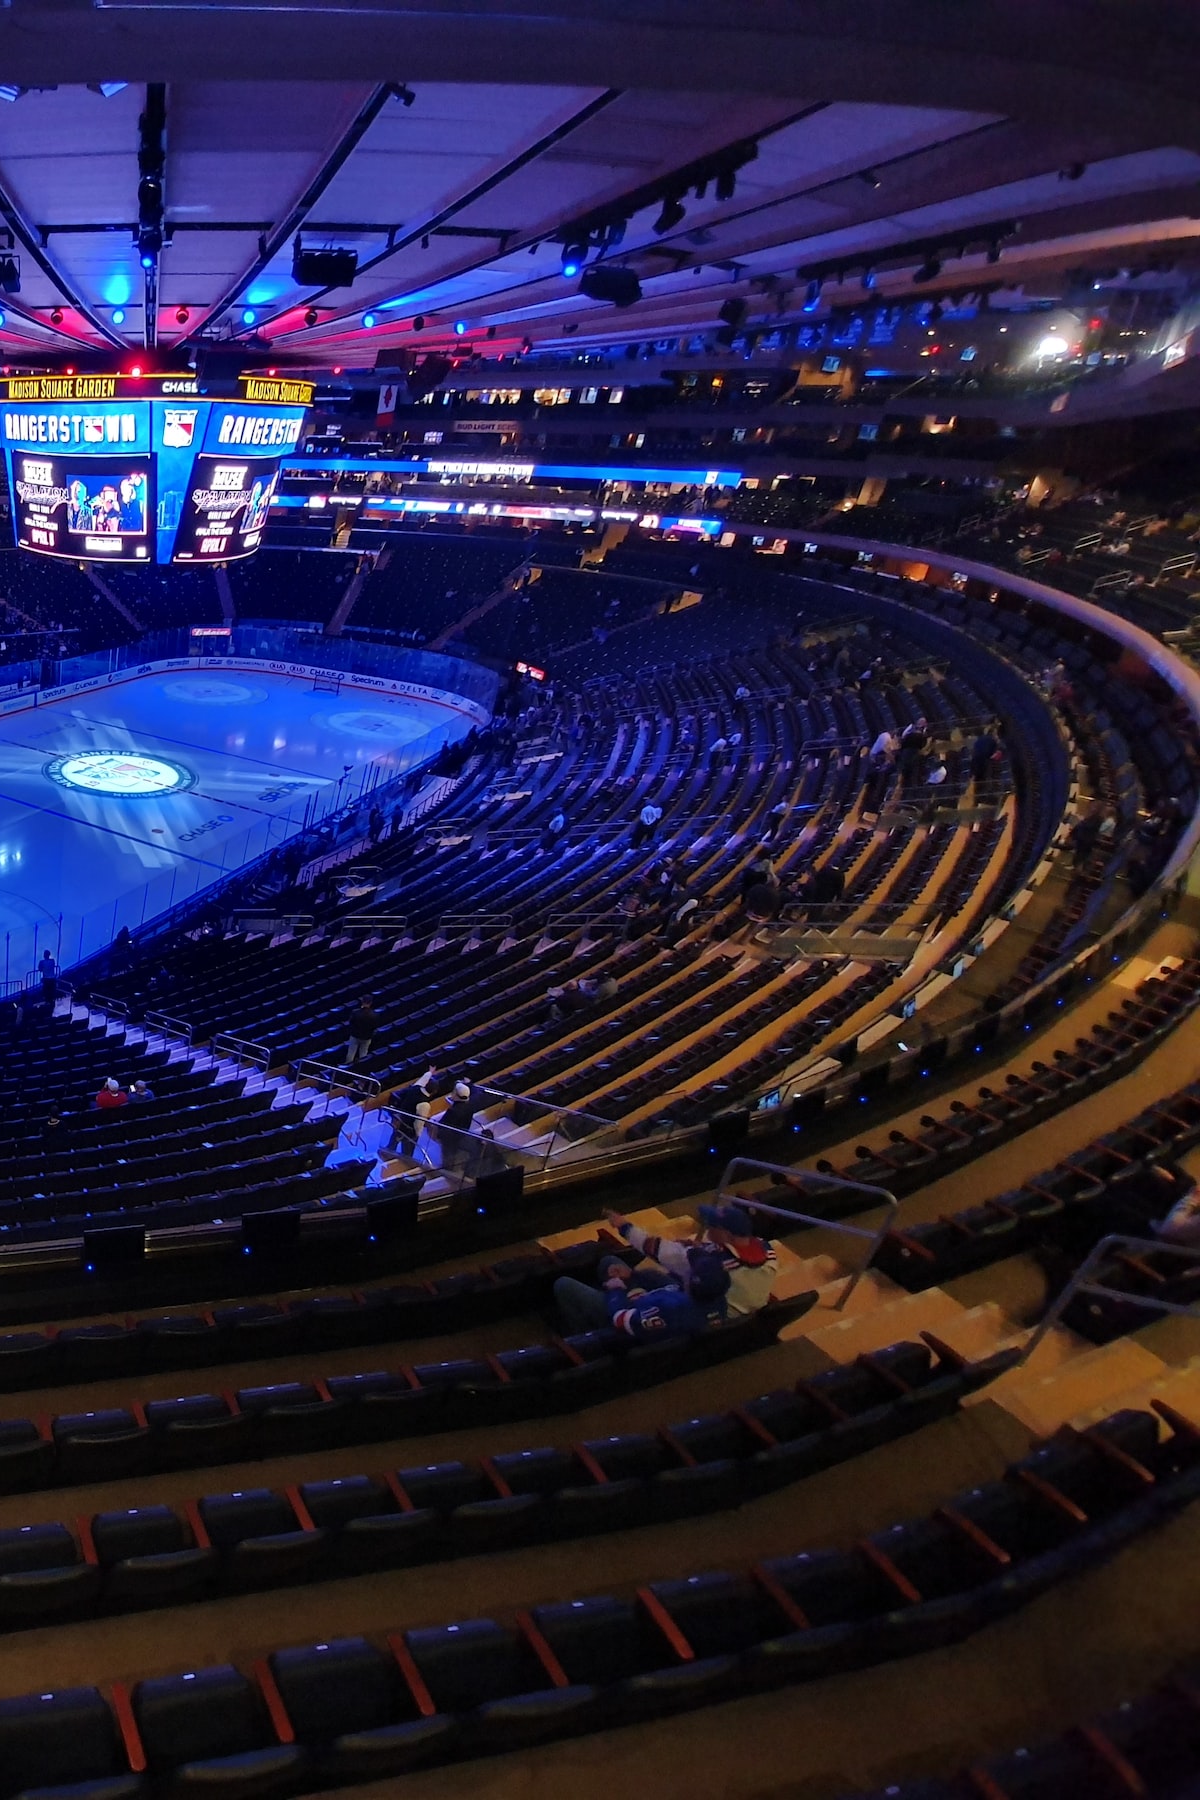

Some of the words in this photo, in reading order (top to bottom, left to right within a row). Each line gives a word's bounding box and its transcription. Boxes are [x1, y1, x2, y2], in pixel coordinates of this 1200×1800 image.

[8, 380, 39, 399] MADISON
[40, 379, 73, 399] SQUARE
[75, 378, 115, 398] GARDEN
[246, 380, 281, 401] MADISON
[351, 675, 385, 687] Spectrum
[400, 685, 429, 696] DELTA
[178, 820, 220, 842] CHASE
